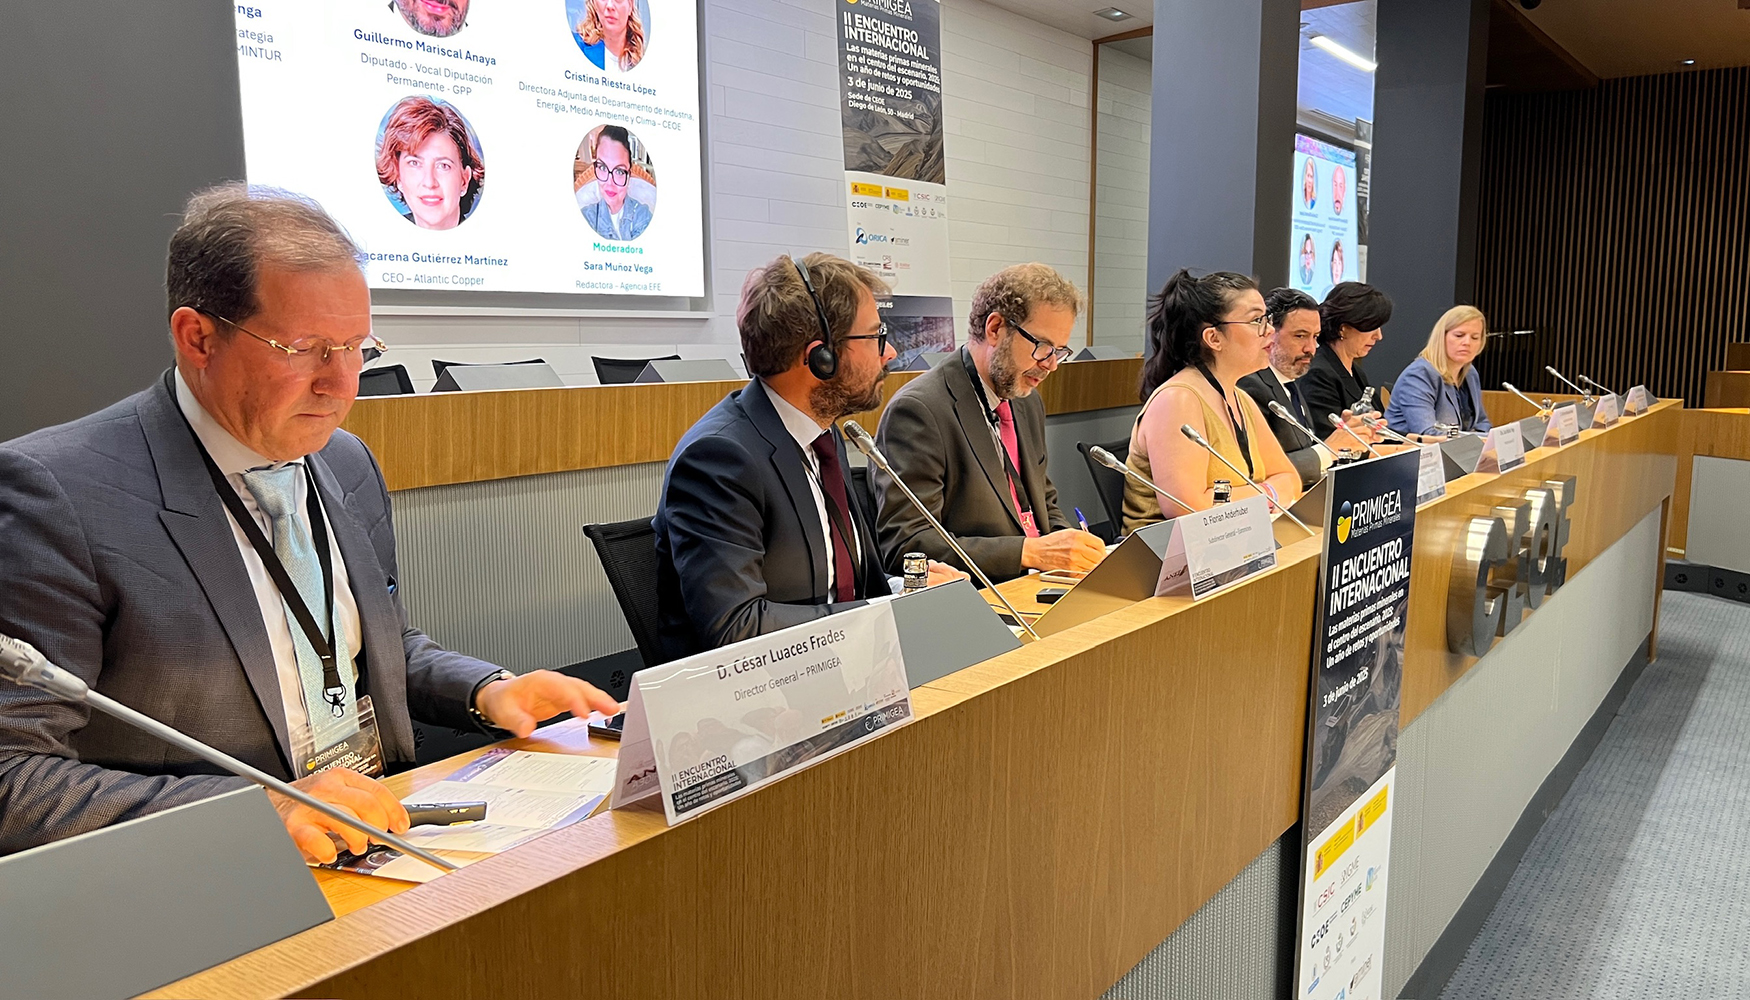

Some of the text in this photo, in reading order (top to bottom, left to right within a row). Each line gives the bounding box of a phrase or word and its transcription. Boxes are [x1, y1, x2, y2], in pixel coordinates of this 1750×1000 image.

[234, 4, 262, 19] nga
[844, 11, 918, 43] II ENCUENTRO
[354, 28, 496, 67] Guillermo Mariscal Anaya
[844, 25, 930, 61] INTERNACIONAL
[361, 52, 407, 70] Diputado
[415, 63, 442, 76] Vocal
[444, 68, 493, 85] Diputación
[846, 42, 938, 75] Las materias primas minerales
[846, 54, 858, 62] en
[858, 55, 866, 64] el
[866, 58, 886, 70] centro
[887, 63, 897, 73] del
[386, 73, 445, 93] Permanente
[453, 85, 472, 96] GPP
[564, 70, 657, 97] Cristina Riestra López
[847, 62, 941, 93] Un año de retos y oportunidades
[847, 76, 913, 100] 3 de junio de 2025
[519, 81, 556, 96] Directora
[557, 89, 587, 102] Adjunta
[589, 95, 601, 104] del
[602, 96, 653, 114] Departamento
[654, 106, 663, 115] de
[847, 92, 864, 101] Sede
[864, 94, 872, 102] de
[848, 100, 867, 110] Diego
[867, 103, 874, 111] de
[887, 108, 894, 116] 50
[570, 105, 593, 117] Medio
[594, 109, 630, 123] Ambiente
[635, 115, 657, 127] Clima
[662, 121, 682, 131] CEOE
[916, 193, 931, 201] CSIC
[593, 242, 643, 255] Moderadora
[868, 233, 888, 243] ORICA
[357, 252, 509, 266] acarena Gutiérrez Martínez
[583, 261, 654, 275] Sara Muñoz Vega
[382, 272, 405, 284] CEO
[414, 273, 450, 285] Atlantic
[451, 274, 485, 287] Copper
[575, 279, 661, 292] Redactora Agencia EFE
[1352, 489, 1402, 529] PRIMIGEA
[1332, 537, 1402, 590] II ENCUENTRO
[1329, 556, 1410, 617] INTERNACIONAL
[1328, 624, 1338, 638] Las
[1338, 611, 1360, 632] materias
[1360, 604, 1377, 622] primas
[1398, 588, 1404, 599] en
[1327, 639, 1333, 653] el
[1333, 632, 1350, 649] centro
[1350, 625, 1359, 639] del
[716, 628, 846, 681] D. César Luaces Frades
[1326, 656, 1335, 669] Un
[1335, 649, 1345, 665] año
[1345, 644, 1352, 657] de
[1352, 640, 1365, 654] retos
[733, 682, 767, 702] Director
[768, 670, 799, 690] General
[805, 657, 843, 677] PRIMIGEA
[1323, 667, 1369, 708] 3 de junio de 2025
[873, 706, 904, 725] PRIMIGEA
[315, 741, 349, 764] PRIMIGEA
[671, 754, 728, 782] II ENCUENTRO
[673, 760, 737, 791] INTERNACIONAL
[1317, 882, 1336, 908] CSIC
